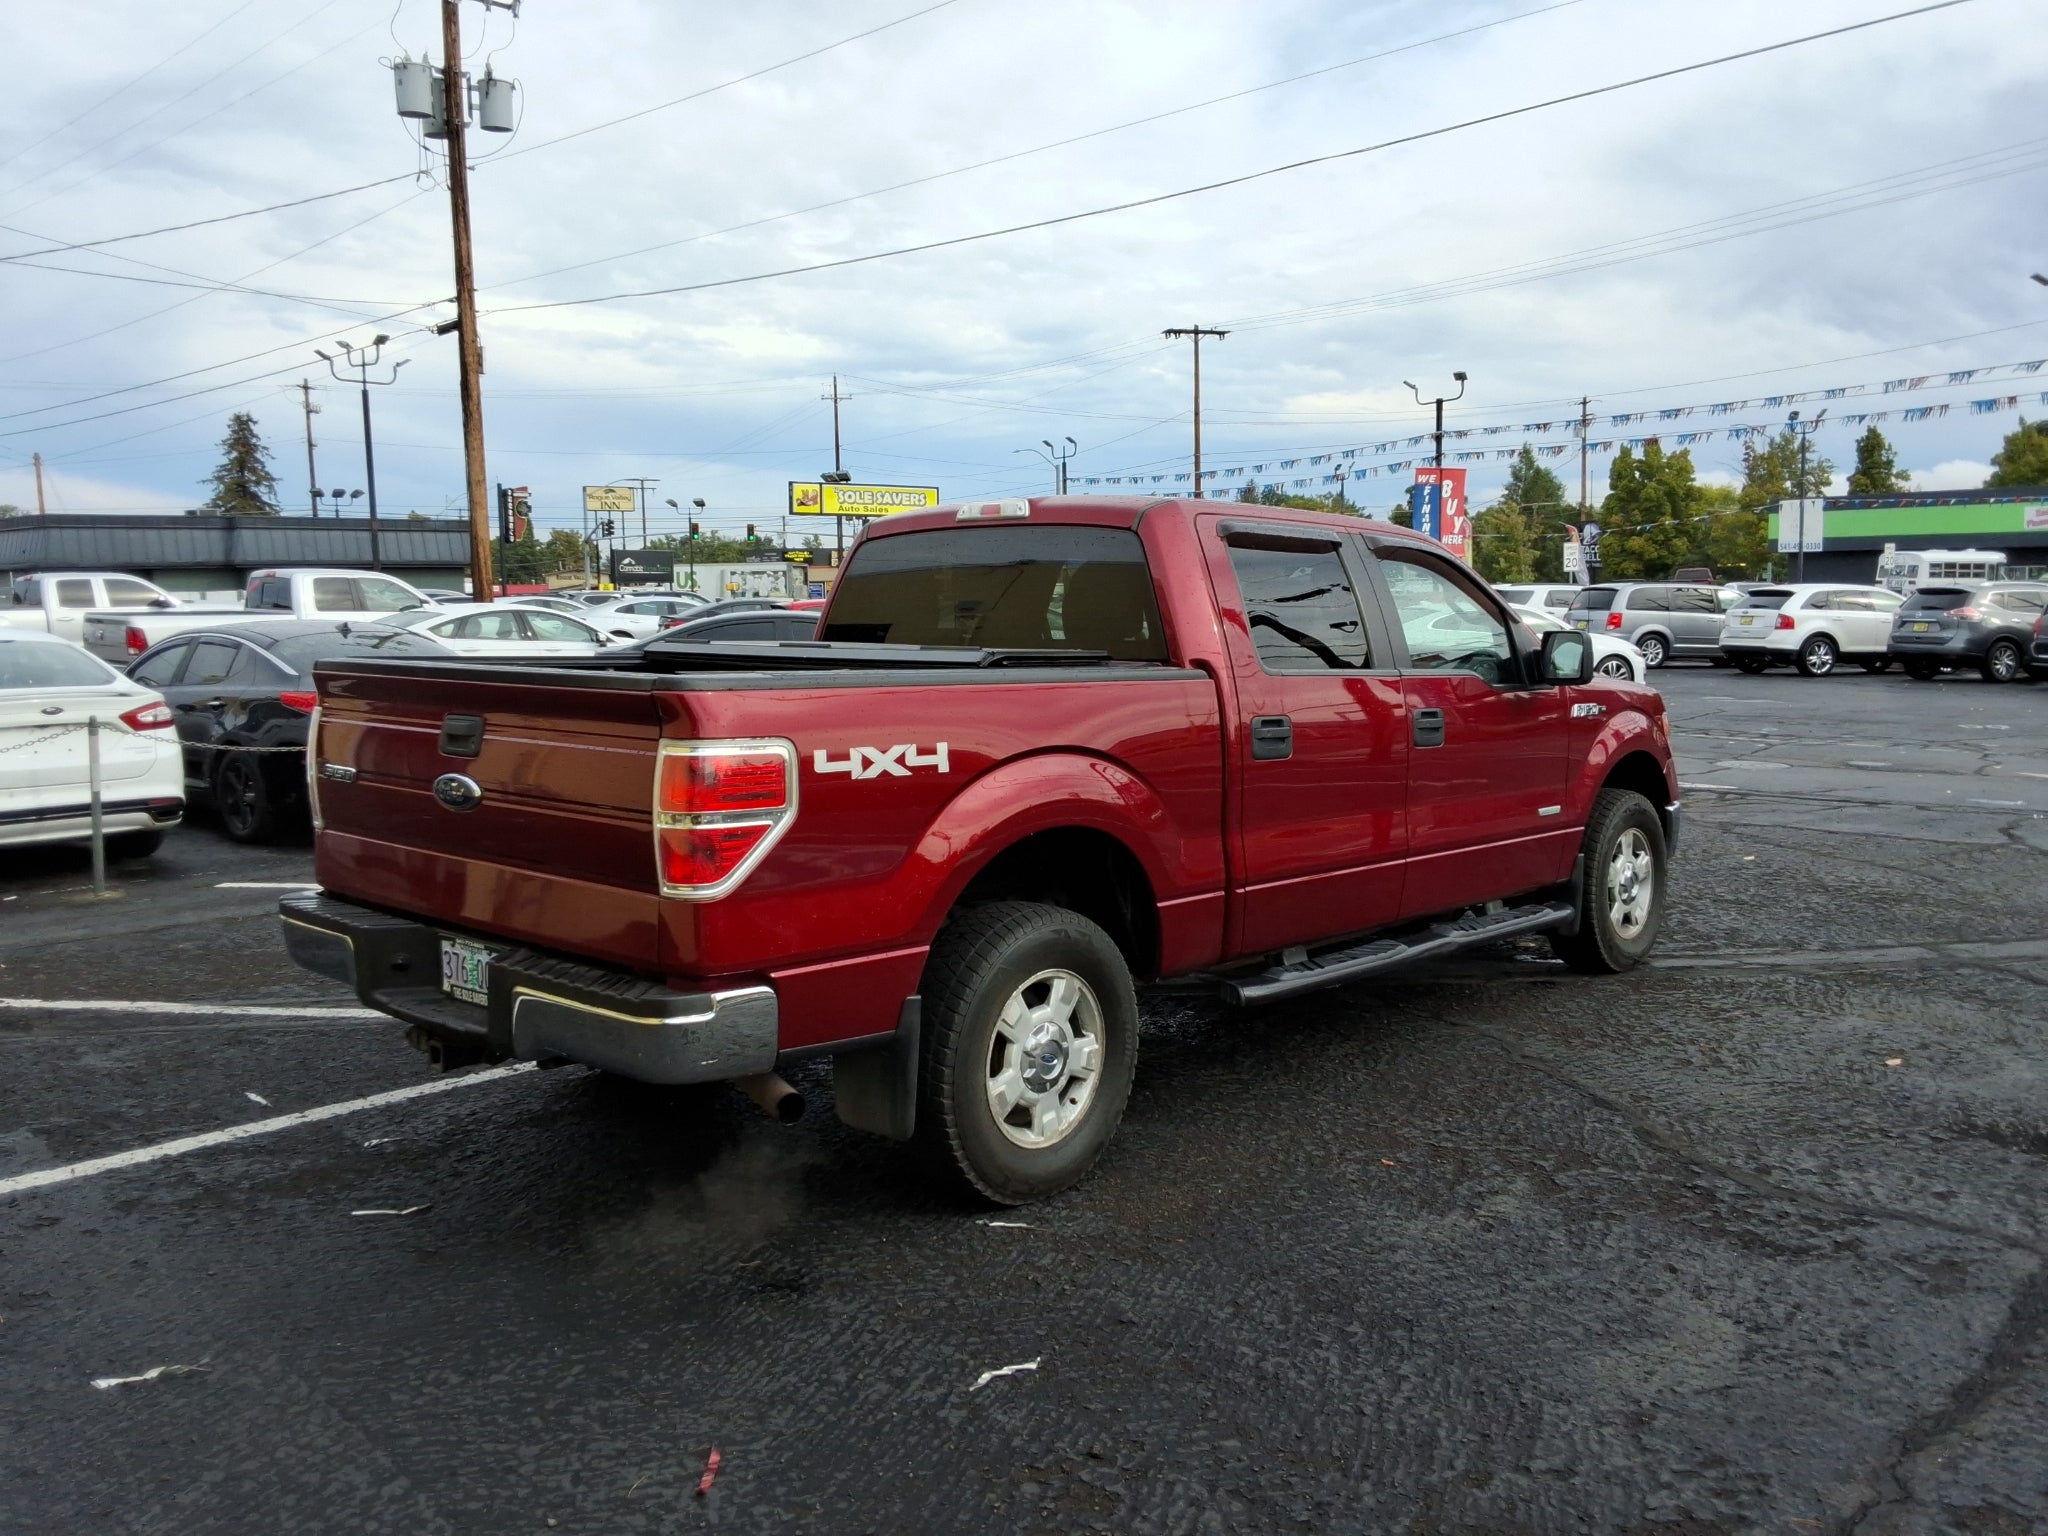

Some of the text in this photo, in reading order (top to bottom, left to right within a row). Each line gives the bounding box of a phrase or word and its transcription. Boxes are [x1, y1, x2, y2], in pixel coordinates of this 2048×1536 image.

[1417, 474, 1437, 483] WE
[837, 490, 927, 507] SOLE SAVERS
[600, 501, 620, 510] INN
[838, 505, 889, 514] Auto Sales
[1441, 480, 1464, 534] BUY
[1442, 534, 1464, 545] HERE
[1565, 557, 1578, 568] 20
[813, 741, 950, 780] 4X4
